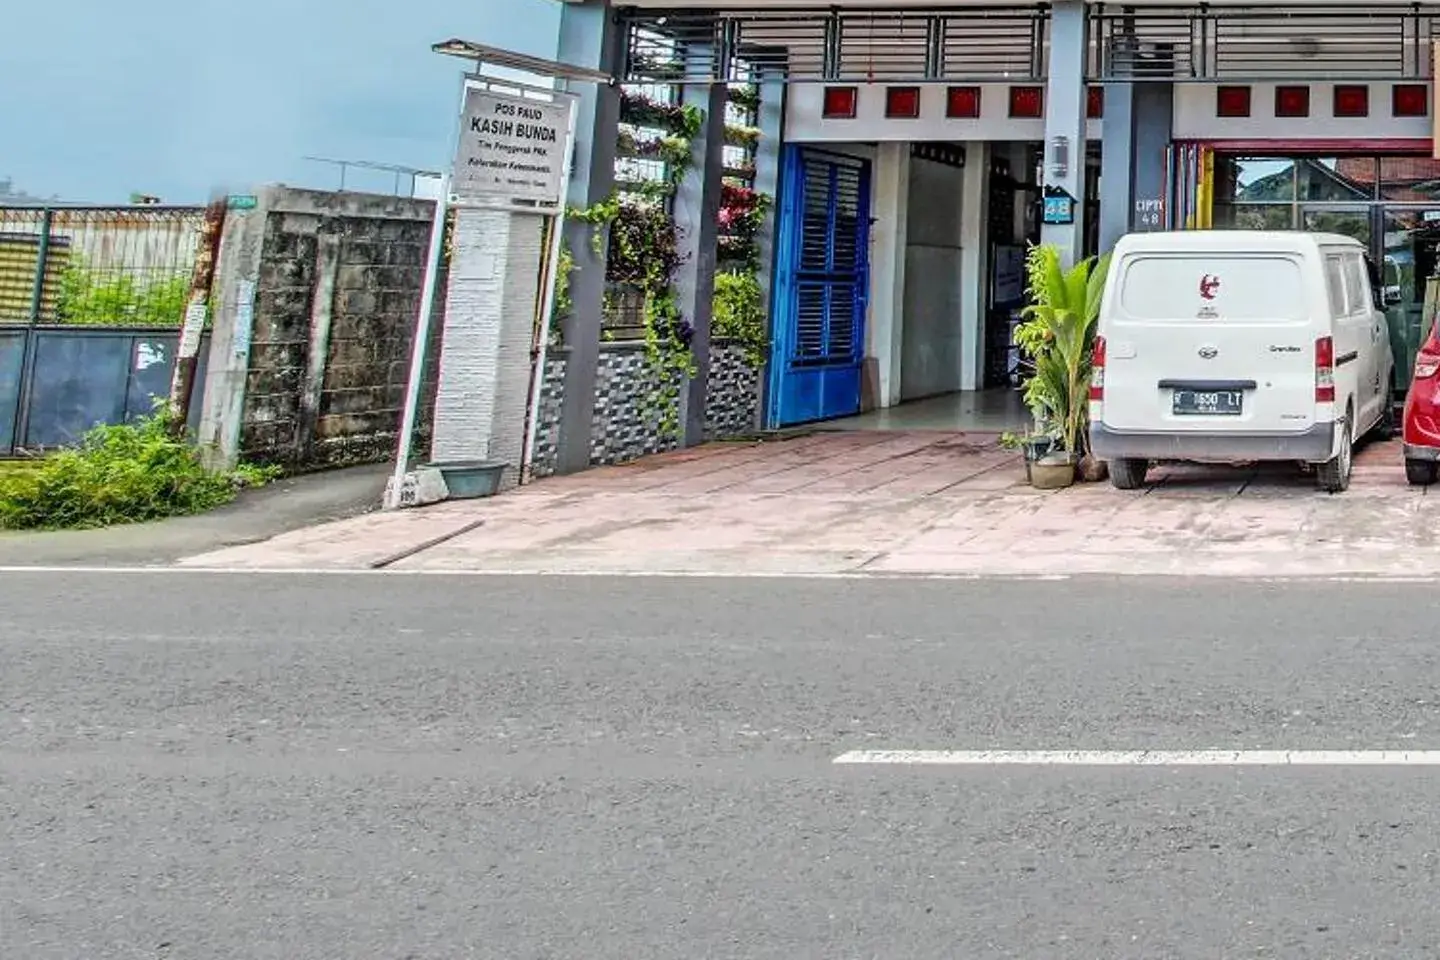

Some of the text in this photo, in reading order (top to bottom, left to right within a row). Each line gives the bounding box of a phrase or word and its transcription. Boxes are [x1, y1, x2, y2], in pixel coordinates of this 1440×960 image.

[494, 103, 542, 120] POS PAUD
[470, 117, 556, 142] KASIH BUNDA
[1044, 198, 1071, 215] 48
[1142, 213, 1159, 225] 48
[1228, 392, 1241, 406] LT
